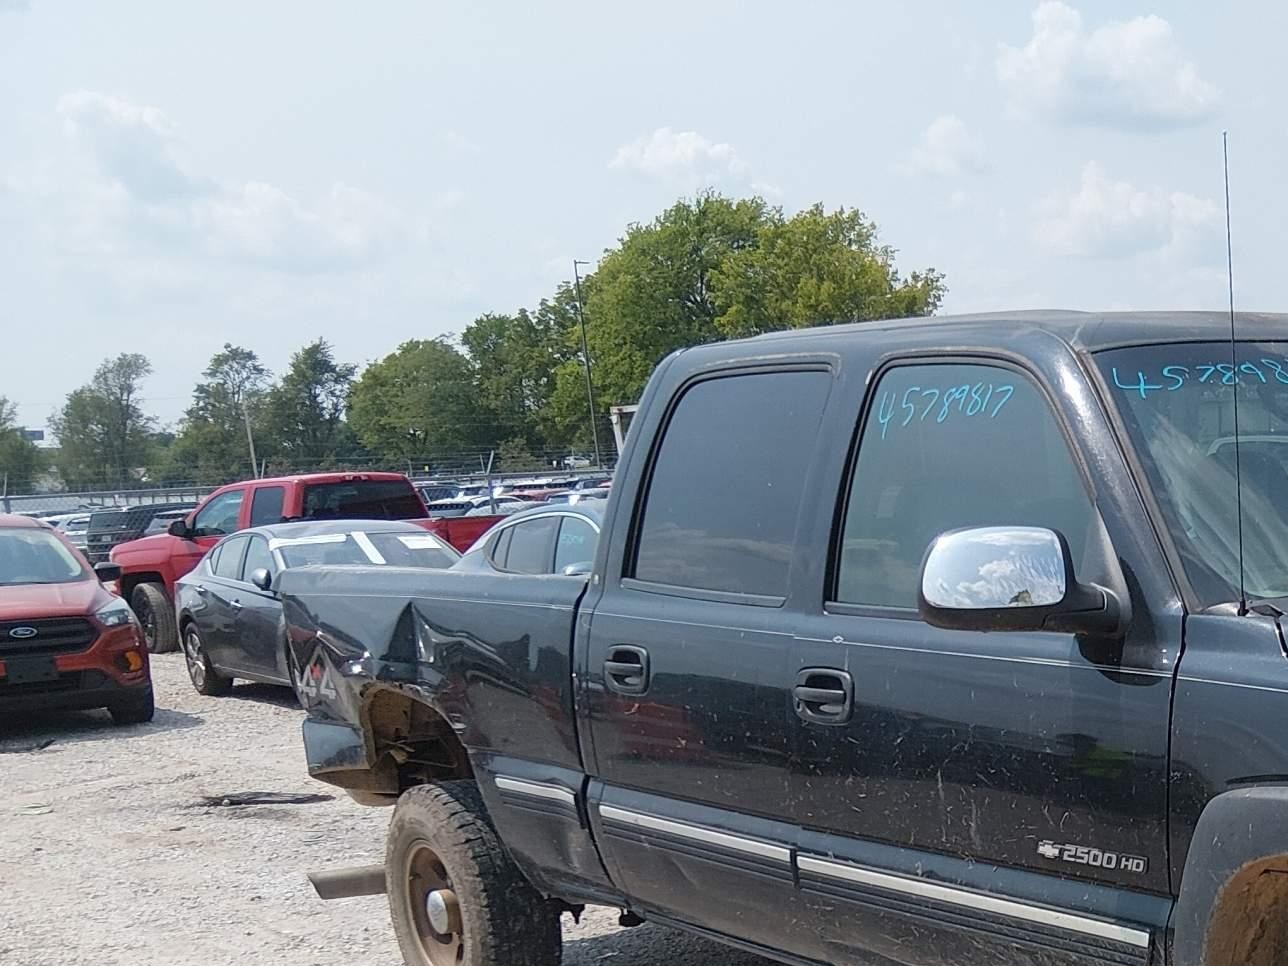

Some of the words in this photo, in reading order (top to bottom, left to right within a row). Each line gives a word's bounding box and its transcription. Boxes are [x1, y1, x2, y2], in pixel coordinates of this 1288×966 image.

[878, 381, 1014, 440] 45789817
[1063, 847, 1116, 868] 2500
[1120, 857, 1144, 872] HD
